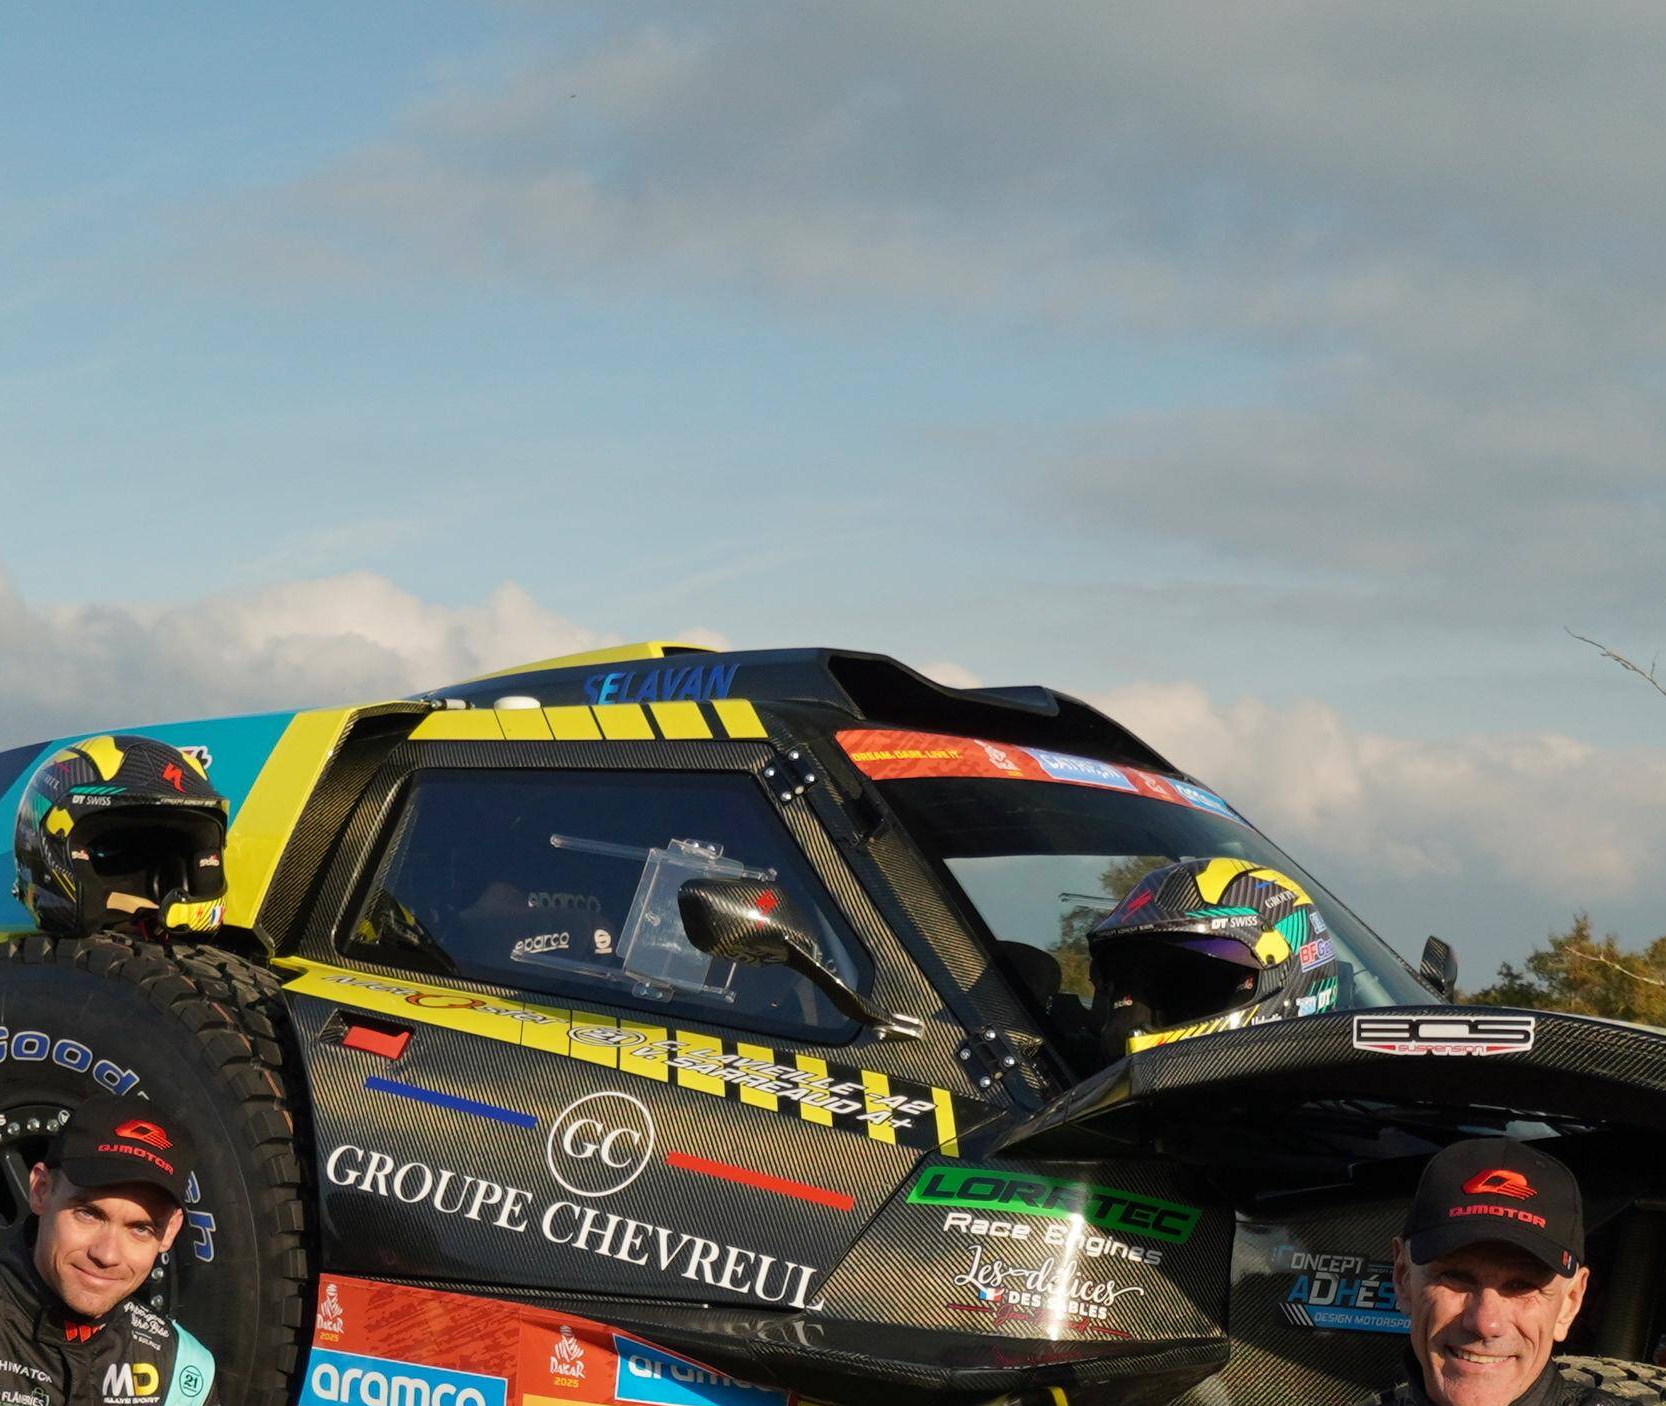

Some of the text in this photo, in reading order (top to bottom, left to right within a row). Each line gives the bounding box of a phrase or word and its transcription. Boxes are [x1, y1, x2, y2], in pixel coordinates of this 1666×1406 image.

[86, 796, 111, 806] SWISS
[1230, 915, 1258, 928] SWISS
[563, 1118, 641, 1168] GC
[325, 1144, 826, 1312] GROUPE CHEVREUL
[1448, 1203, 1546, 1229] QJMOTOR
[943, 1211, 1164, 1266] Race Engines
[1008, 1291, 1042, 1308] DES
[1314, 1311, 1353, 1324] DESIGN
[549, 1355, 586, 1379] DAKAR
[102, 1362, 161, 1397] MD
[554, 1376, 580, 1388] 2025
